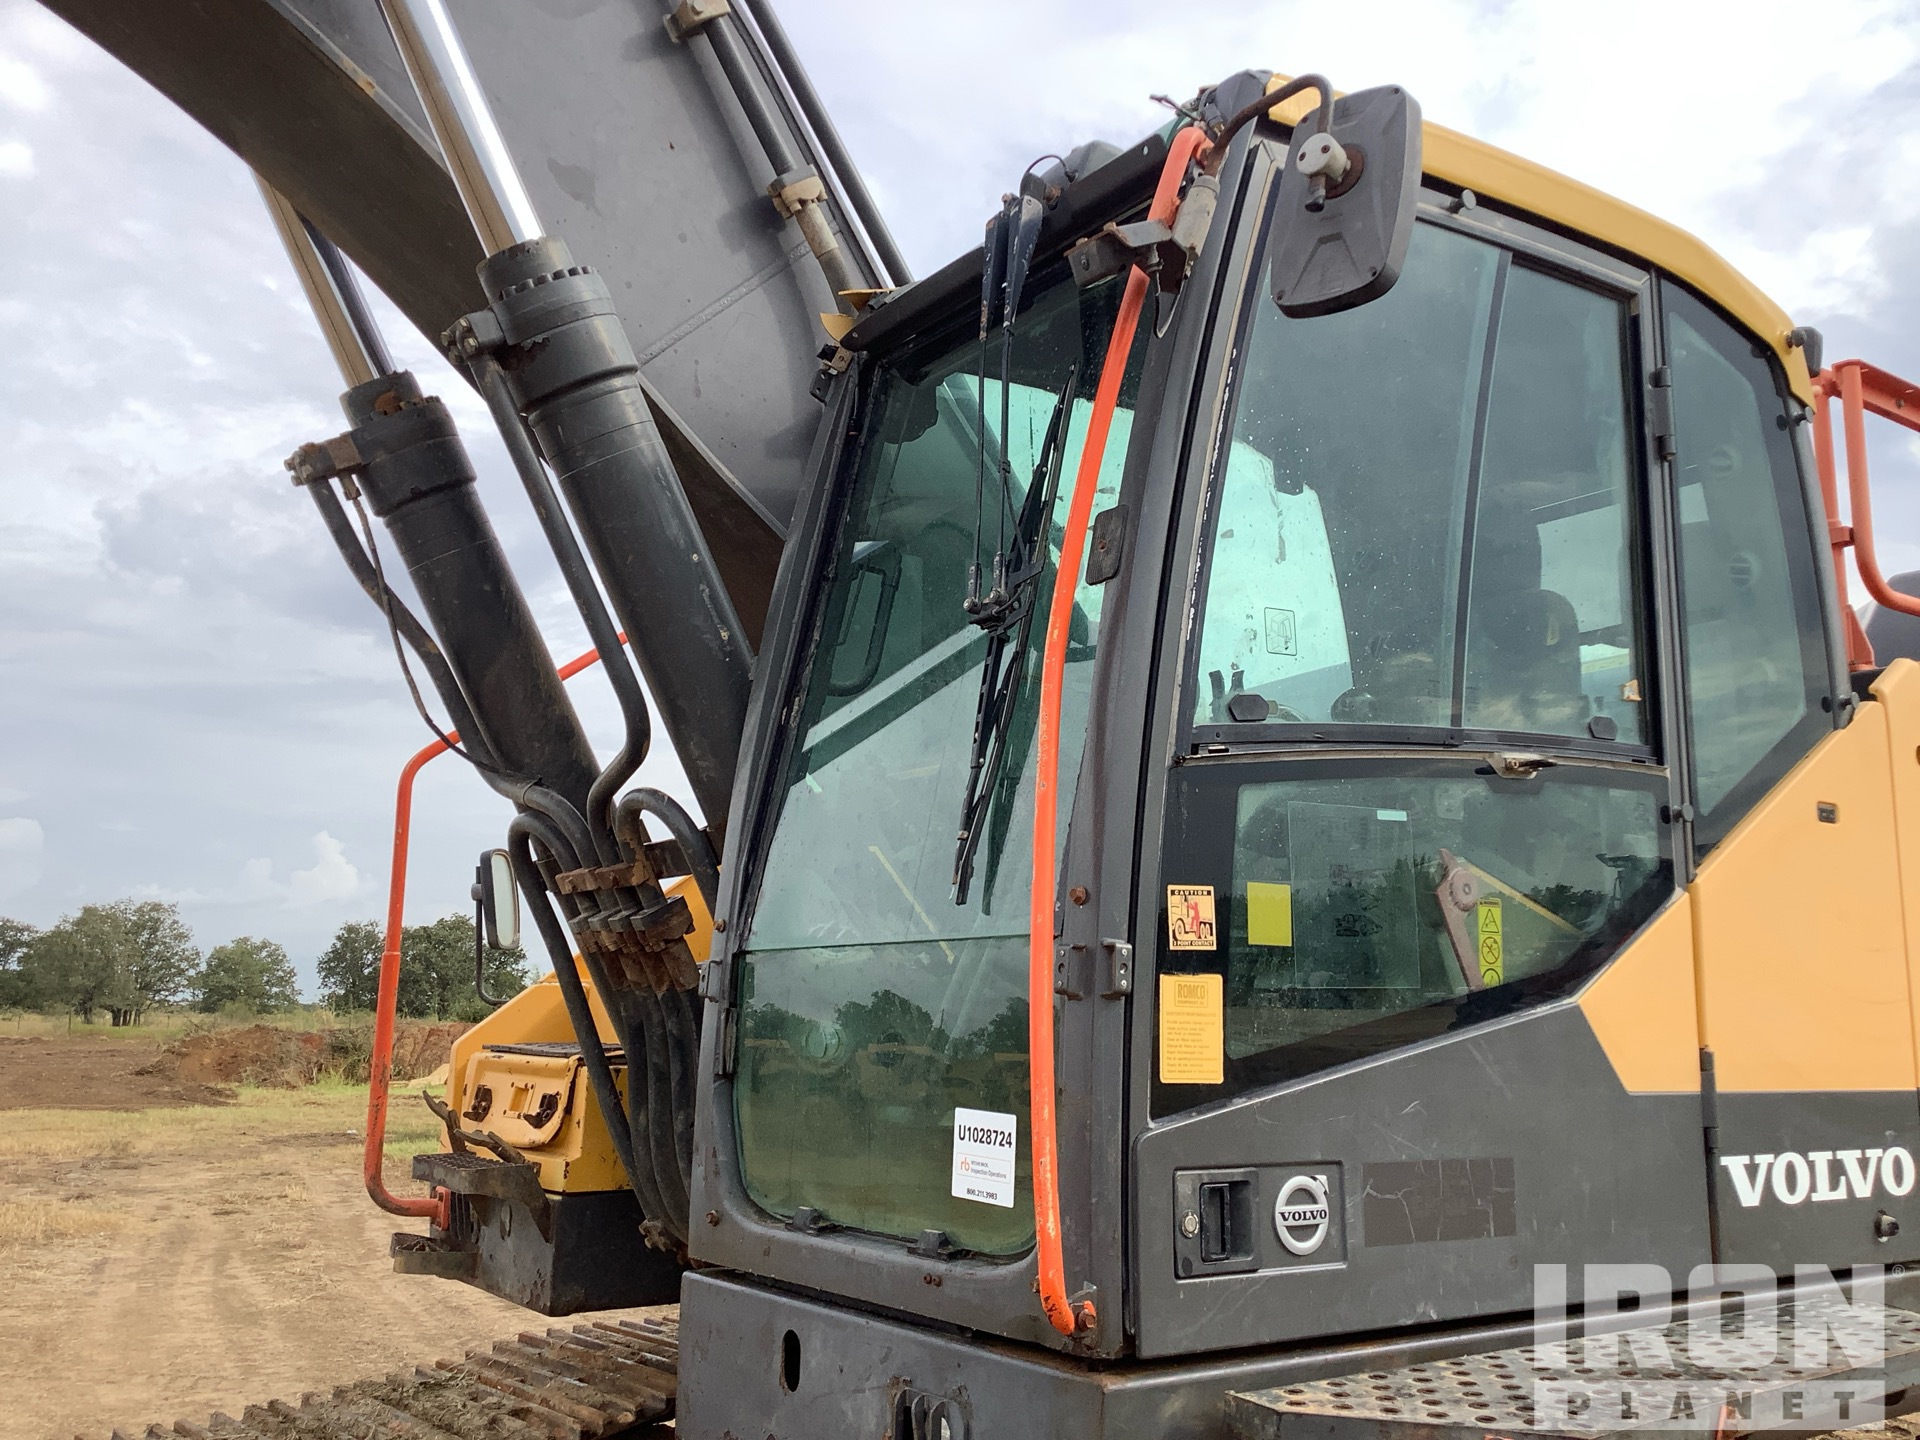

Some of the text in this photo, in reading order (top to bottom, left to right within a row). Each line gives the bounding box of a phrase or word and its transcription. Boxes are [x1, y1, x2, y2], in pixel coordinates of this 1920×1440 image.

[1177, 984, 1205, 999] ROMCO
[958, 1124, 1013, 1148] U1028724
[960, 1156, 970, 1172] rb
[971, 1167, 1007, 1179] Inspection Operations
[1720, 1146, 1916, 1207] VOLVO
[966, 1187, 998, 1201] 800.211.3983
[1278, 1209, 1328, 1222] VOLVO
